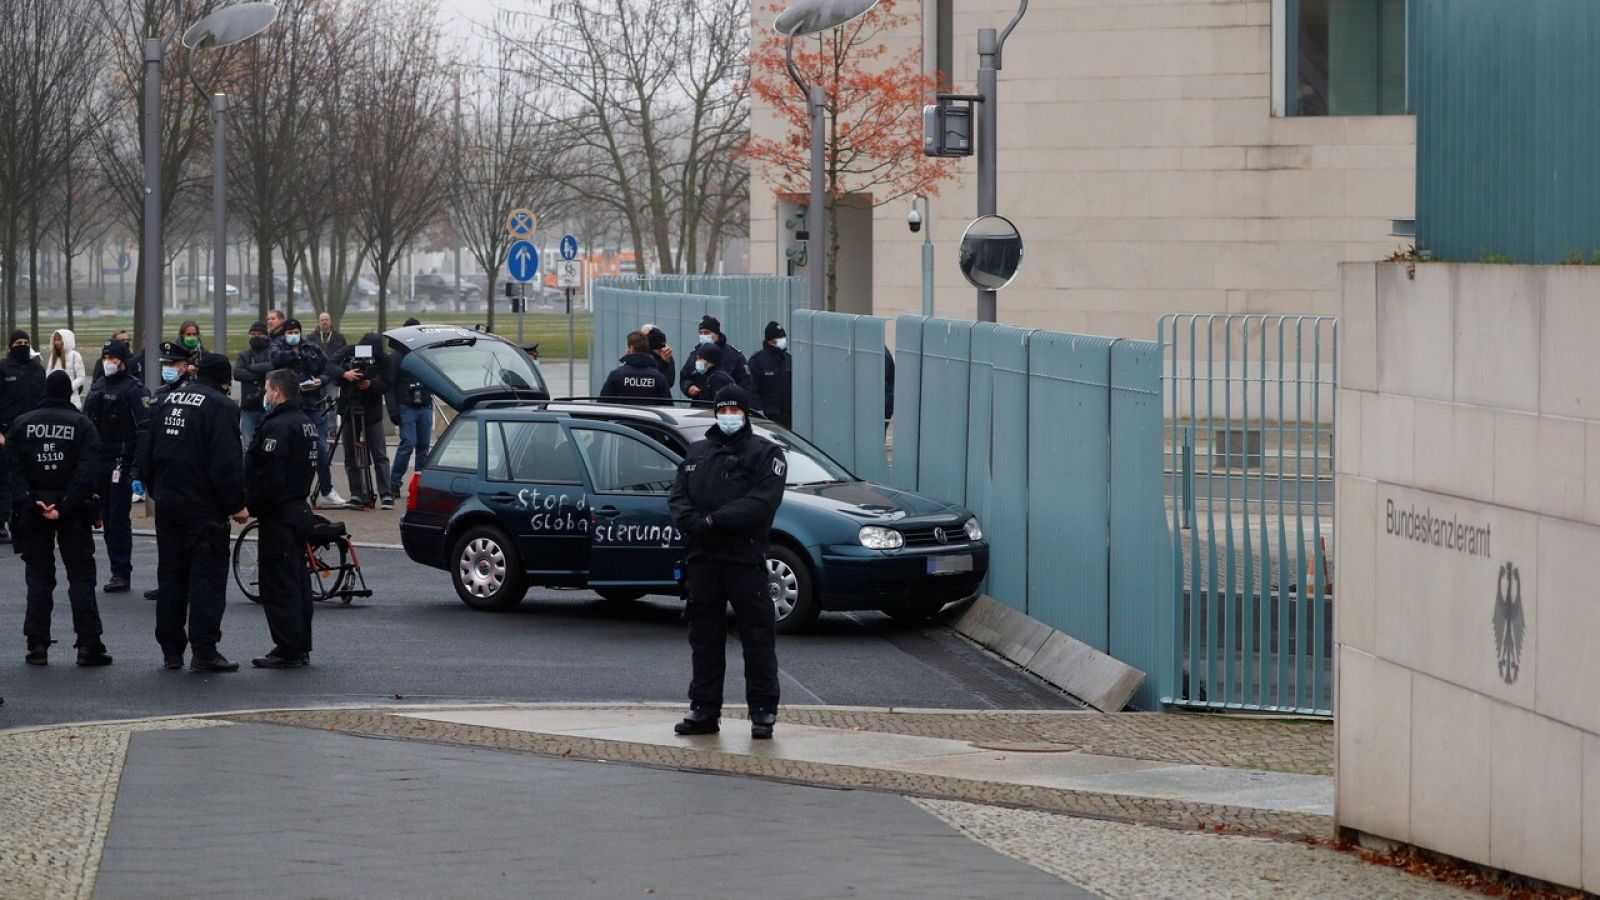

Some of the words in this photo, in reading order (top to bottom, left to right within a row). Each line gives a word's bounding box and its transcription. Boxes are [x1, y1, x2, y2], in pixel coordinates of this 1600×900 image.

[624, 377, 655, 387] POLIZEI
[164, 392, 205, 406] POLIZEI
[171, 408, 183, 417] BE
[164, 417, 185, 427] 15101
[26, 424, 75, 440] POLIZEI
[43, 443, 56, 452] BE
[37, 452, 64, 462] 15110
[515, 488, 567, 515] Stop
[1386, 498, 1491, 559] Bundeskanzleramt
